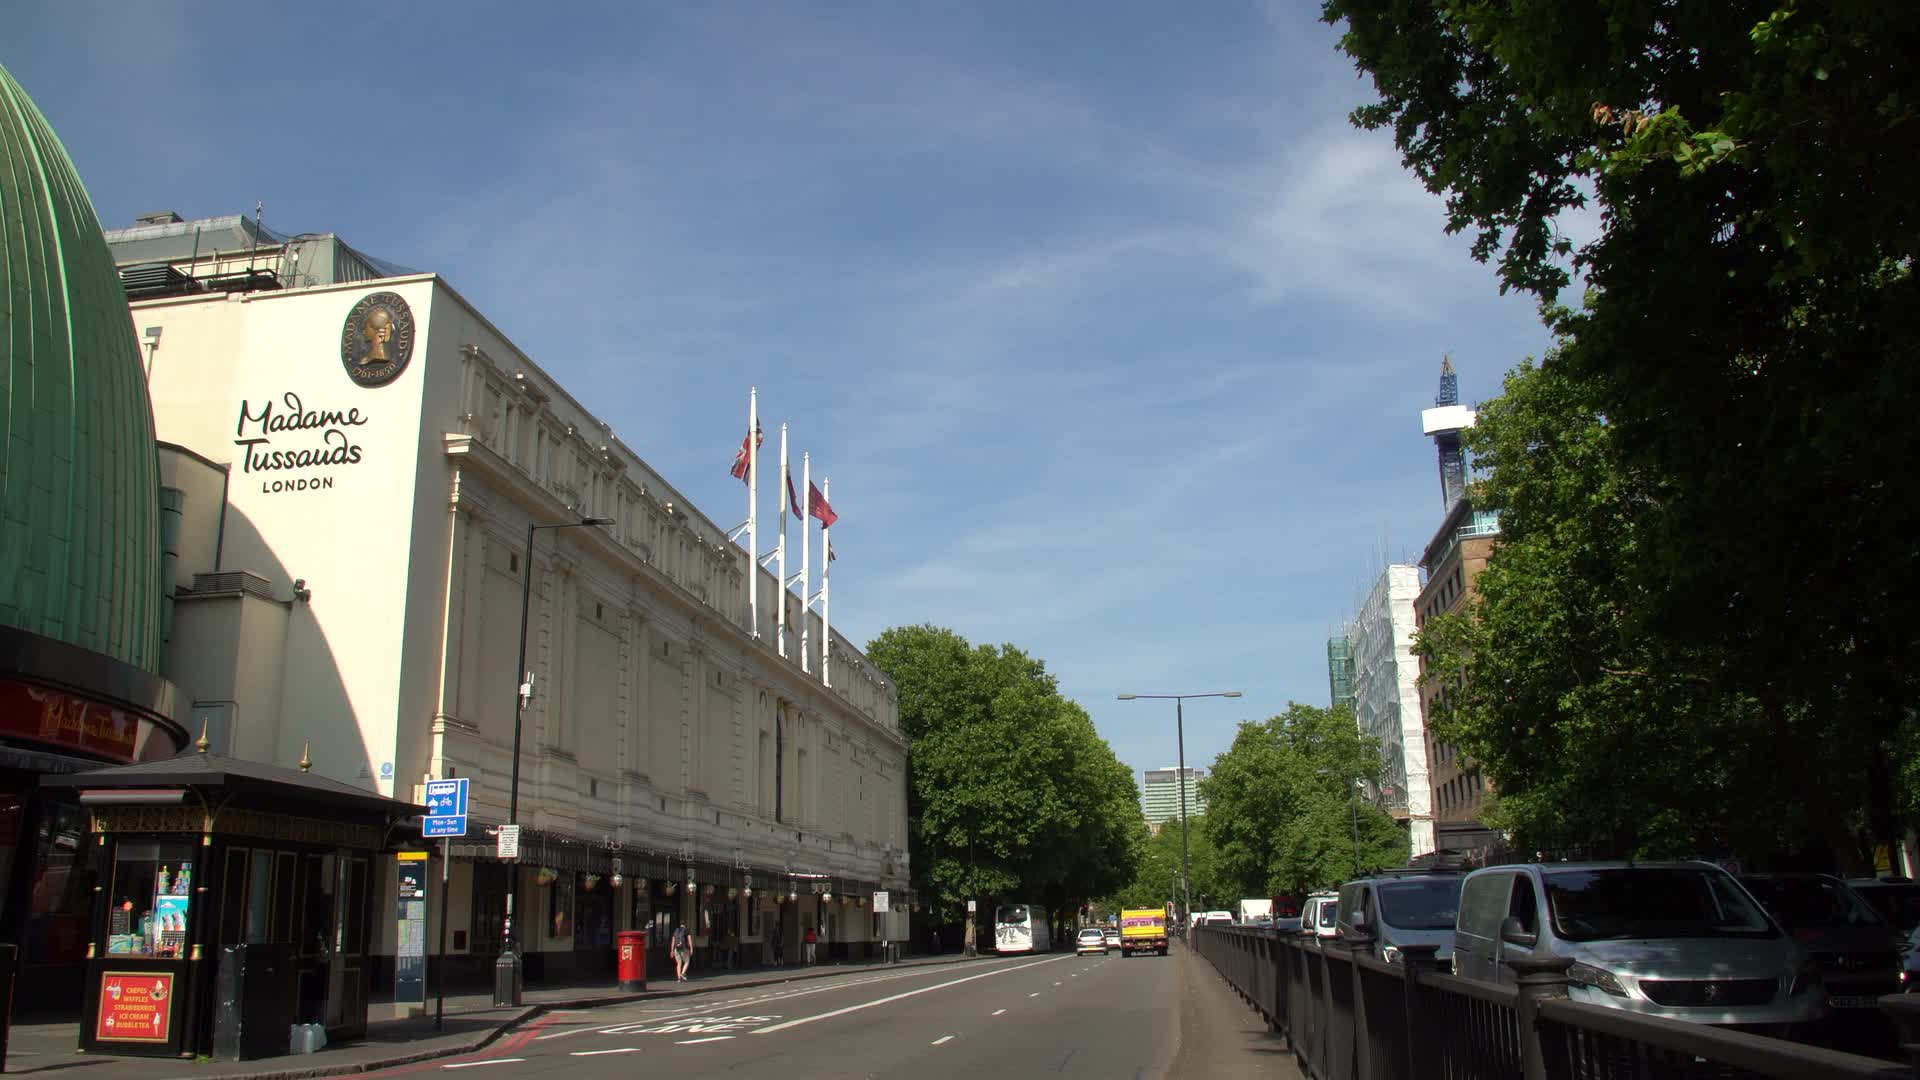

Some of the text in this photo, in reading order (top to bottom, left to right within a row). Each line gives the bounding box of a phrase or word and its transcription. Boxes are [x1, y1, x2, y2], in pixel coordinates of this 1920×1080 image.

[383, 294, 409, 352] TUSSAUD
[237, 391, 369, 437] Madame
[234, 428, 362, 474] Tussauds
[262, 477, 333, 494] LONDON
[597, 1023, 761, 1034] LANE
